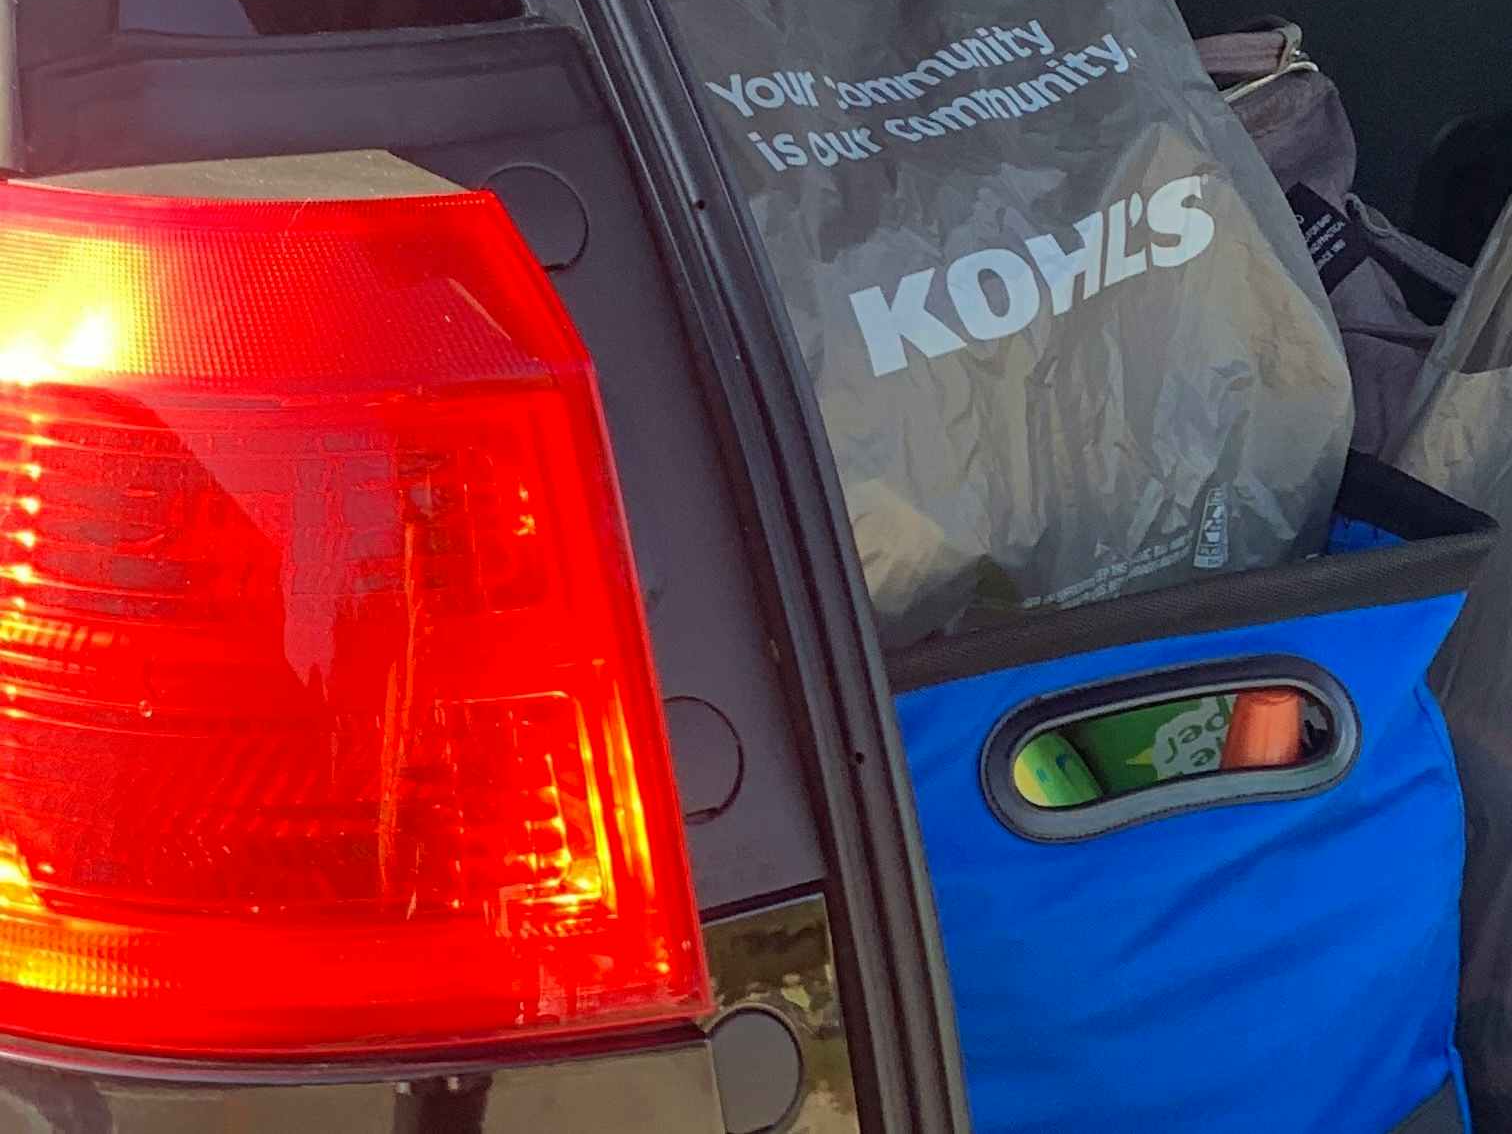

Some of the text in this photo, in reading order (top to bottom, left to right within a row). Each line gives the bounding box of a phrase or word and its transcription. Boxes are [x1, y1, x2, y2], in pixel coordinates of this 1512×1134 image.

[704, 71, 820, 117] Your
[747, 32, 1138, 172] is our community.
[849, 174, 1215, 378] KOHL'S
